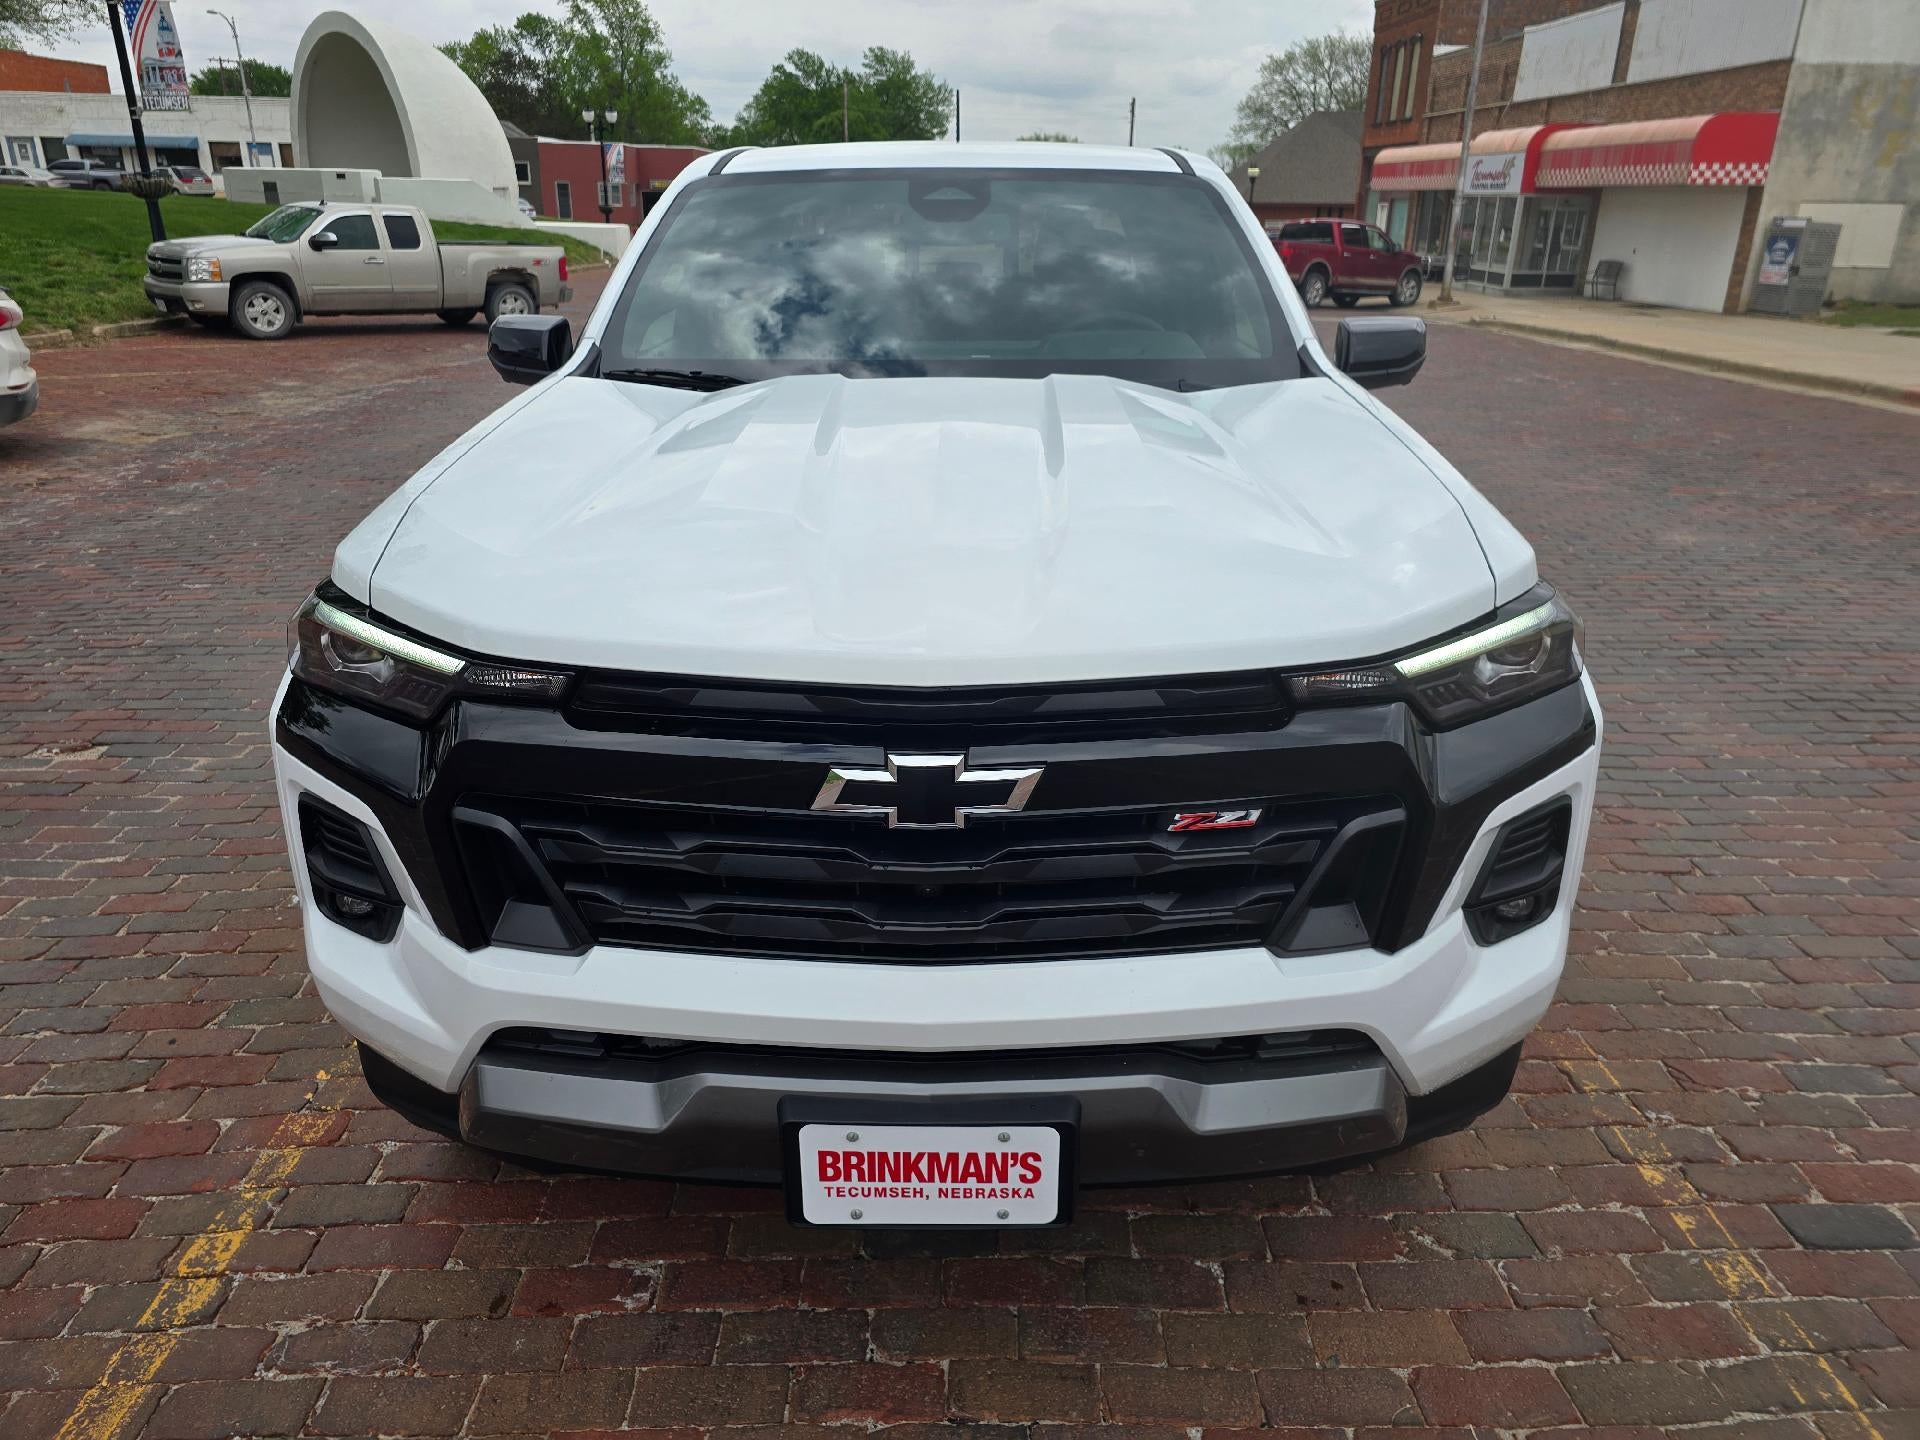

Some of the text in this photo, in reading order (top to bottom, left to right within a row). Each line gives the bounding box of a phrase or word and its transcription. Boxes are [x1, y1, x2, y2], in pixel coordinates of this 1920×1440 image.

[143, 96, 189, 110] TECUMSEH
[1167, 808, 1262, 832] Z71
[817, 1150, 1042, 1184] BRINKMAN'S
[824, 1186, 1035, 1200] TECUMSEH, NEBRASKA
